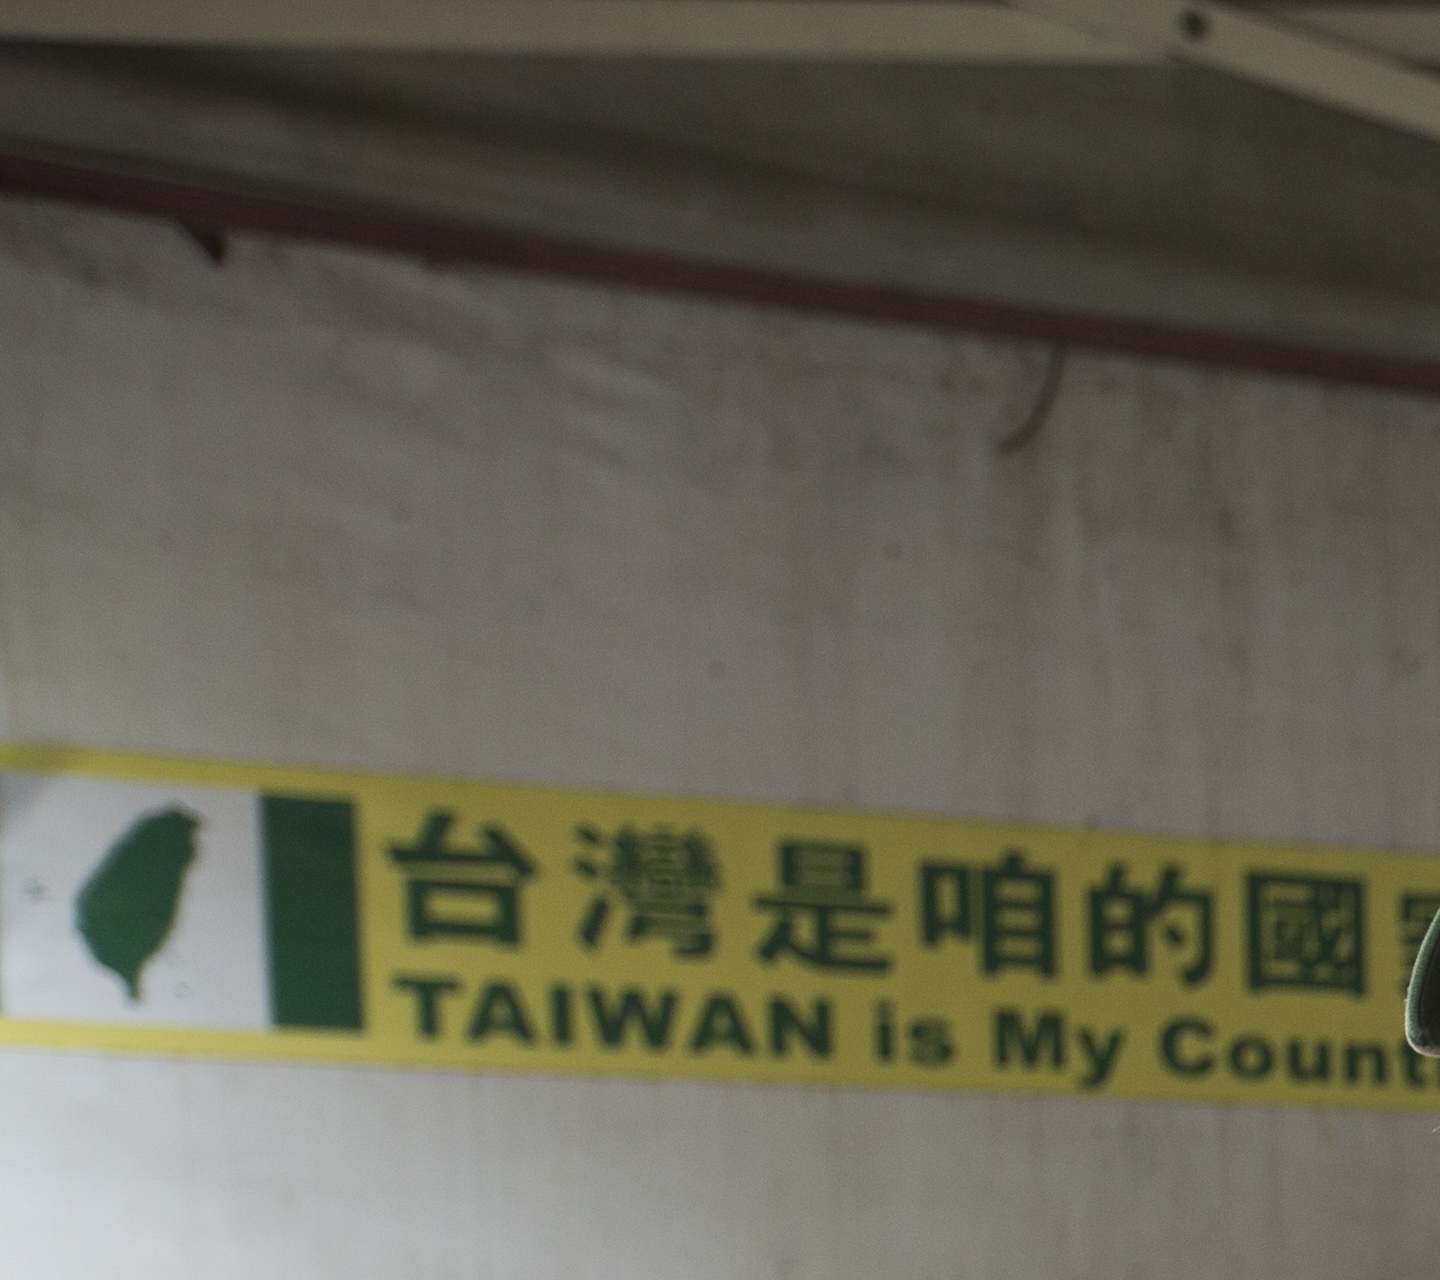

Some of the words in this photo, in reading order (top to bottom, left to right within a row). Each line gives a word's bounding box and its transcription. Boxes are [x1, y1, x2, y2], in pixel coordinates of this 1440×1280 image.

[390, 972, 837, 1065] TAIWAN
[872, 998, 958, 1070] is
[989, 1005, 1127, 1093] My
